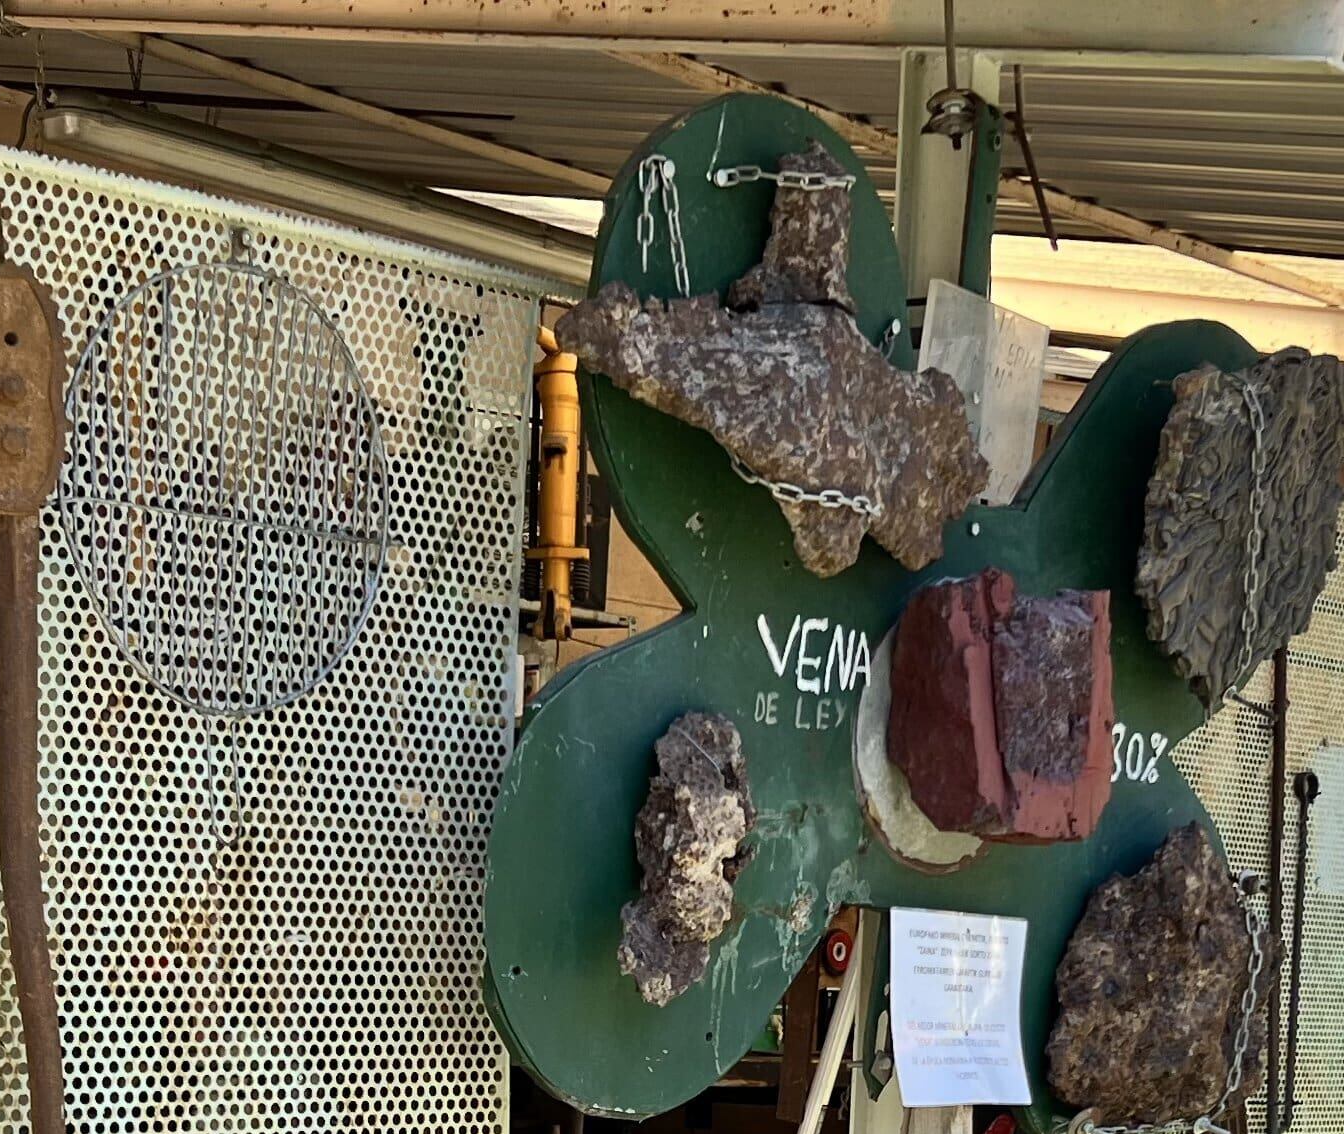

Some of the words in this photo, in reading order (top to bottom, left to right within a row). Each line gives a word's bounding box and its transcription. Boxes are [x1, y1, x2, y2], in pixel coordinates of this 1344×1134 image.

[757, 613, 871, 695] VENA
[754, 691, 779, 725] DE
[795, 696, 847, 730] LEY
[1110, 722, 1168, 784] 30%
